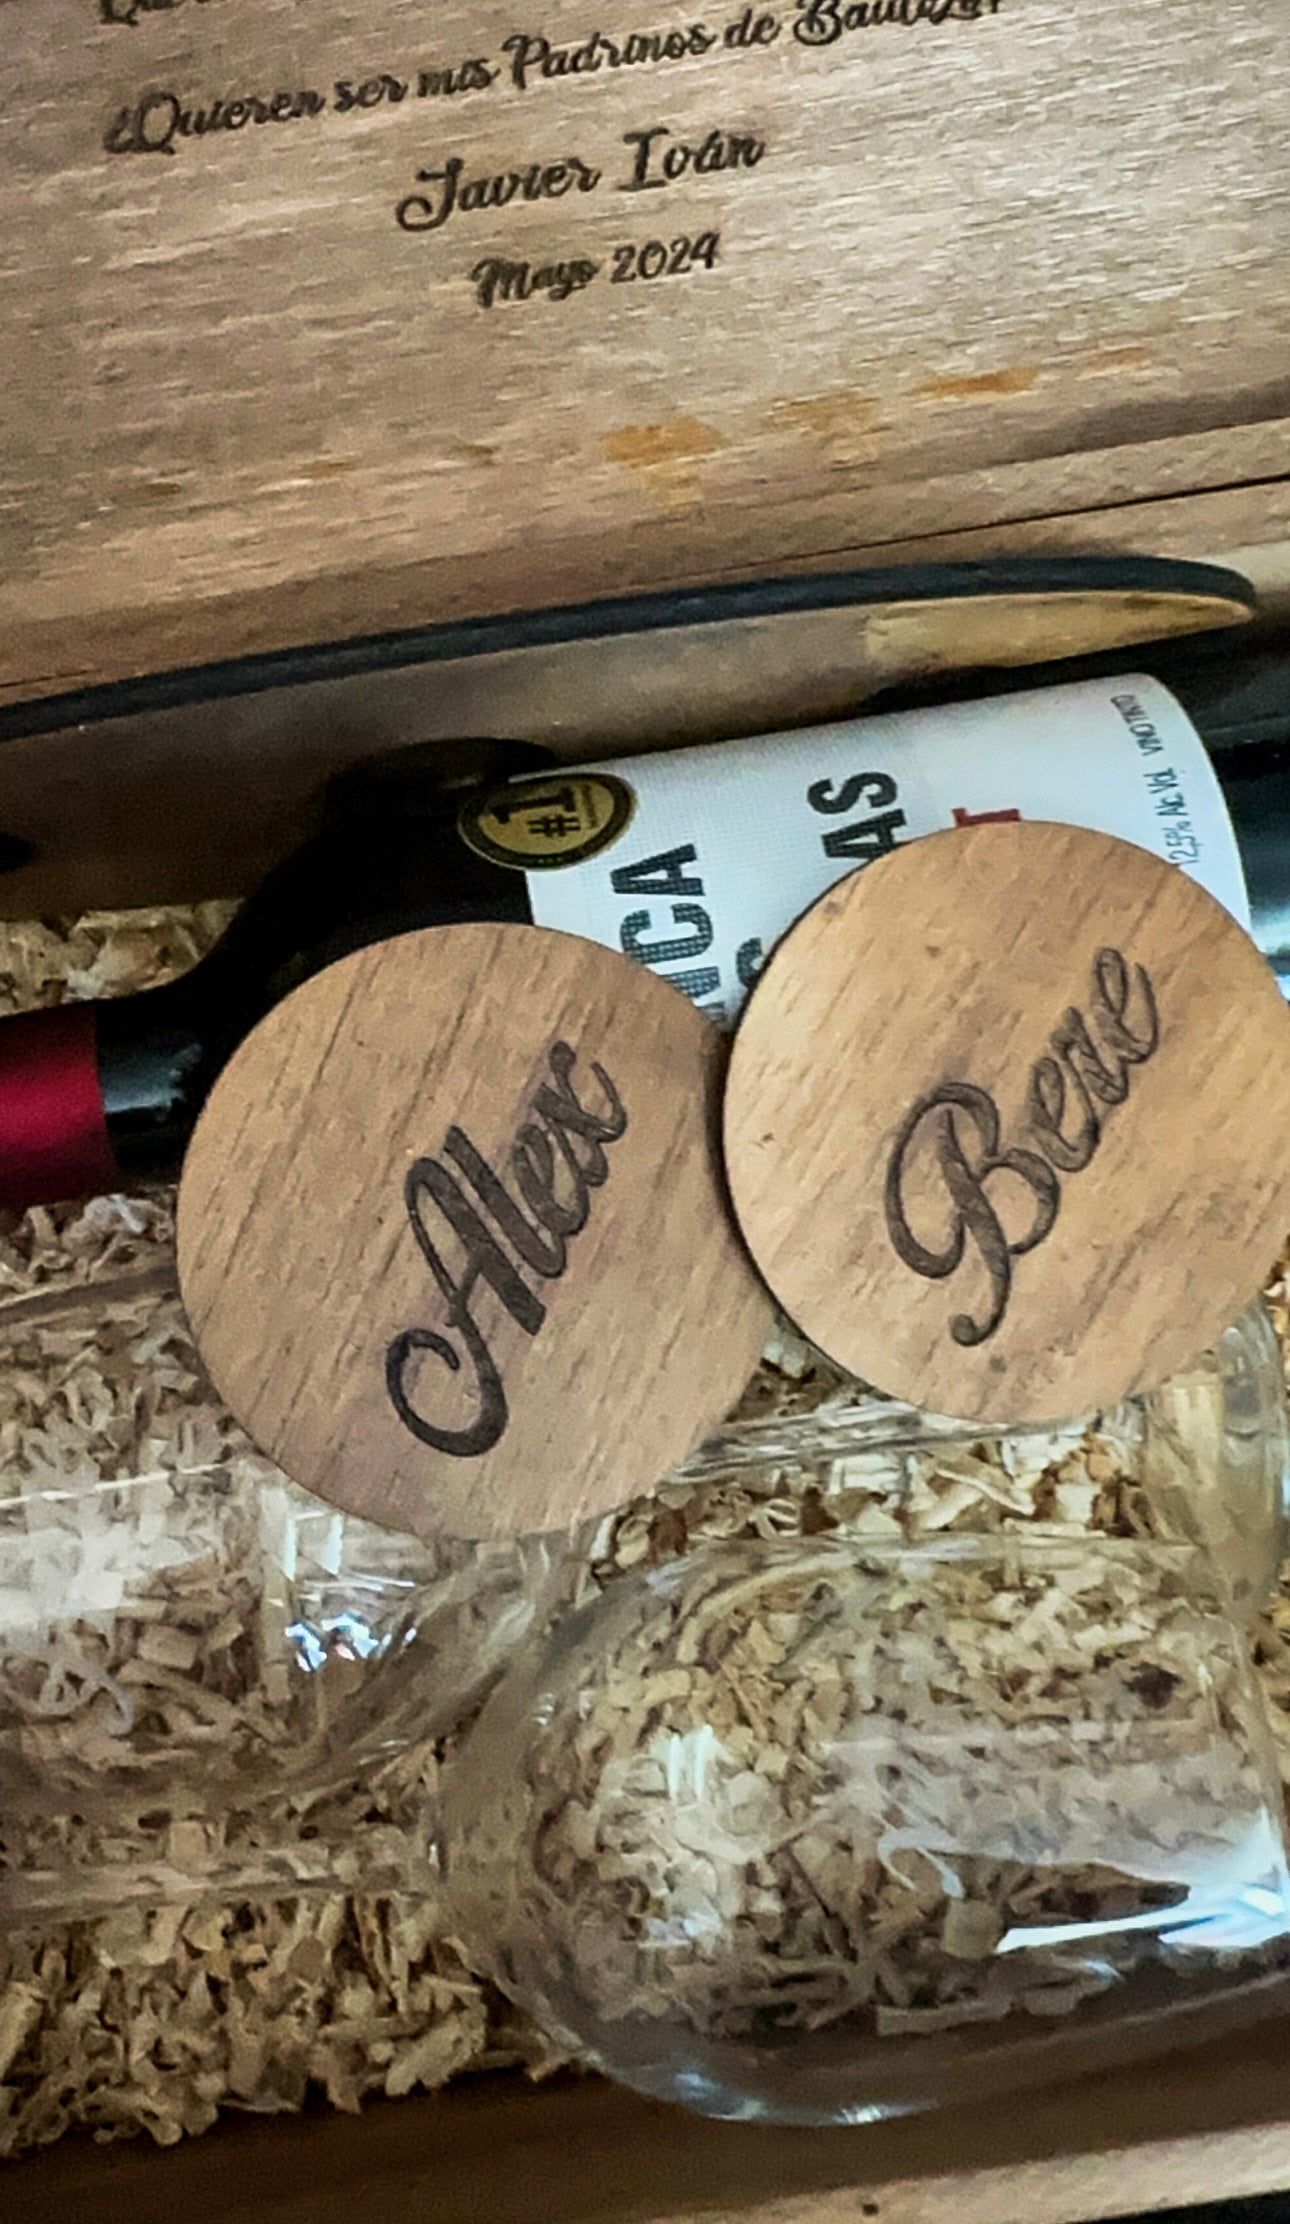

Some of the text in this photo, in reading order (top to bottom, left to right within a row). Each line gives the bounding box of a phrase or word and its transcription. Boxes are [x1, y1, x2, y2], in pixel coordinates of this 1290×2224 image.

[334, 74, 407, 111] ser
[418, 58, 501, 98] mis
[502, 22, 716, 89] Padrinos
[724, 10, 783, 47] de
[394, 156, 602, 231] Javier
[472, 230, 720, 308] Mayo 2024
[386, 1040, 628, 1456] Alex
